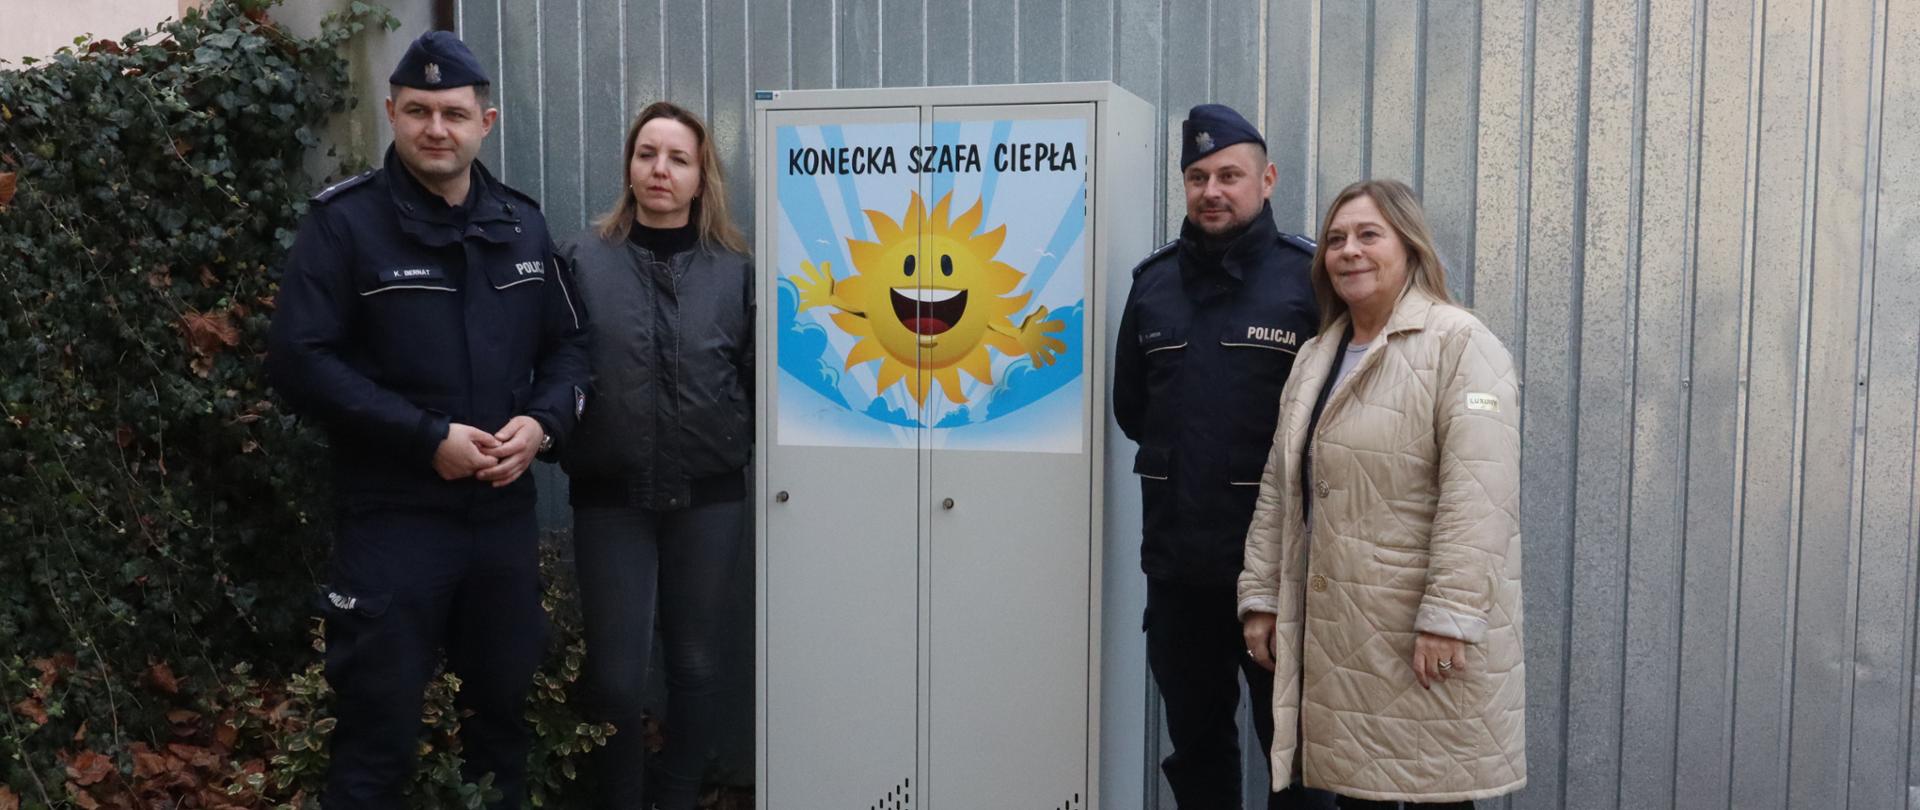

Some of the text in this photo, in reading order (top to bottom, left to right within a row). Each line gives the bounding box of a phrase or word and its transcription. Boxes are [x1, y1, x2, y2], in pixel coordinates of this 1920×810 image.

[788, 142, 1077, 176] KONECKA SZAFA CIEPŁA
[515, 260, 545, 275] POLICJ
[1247, 326, 1296, 346] POLICJA
